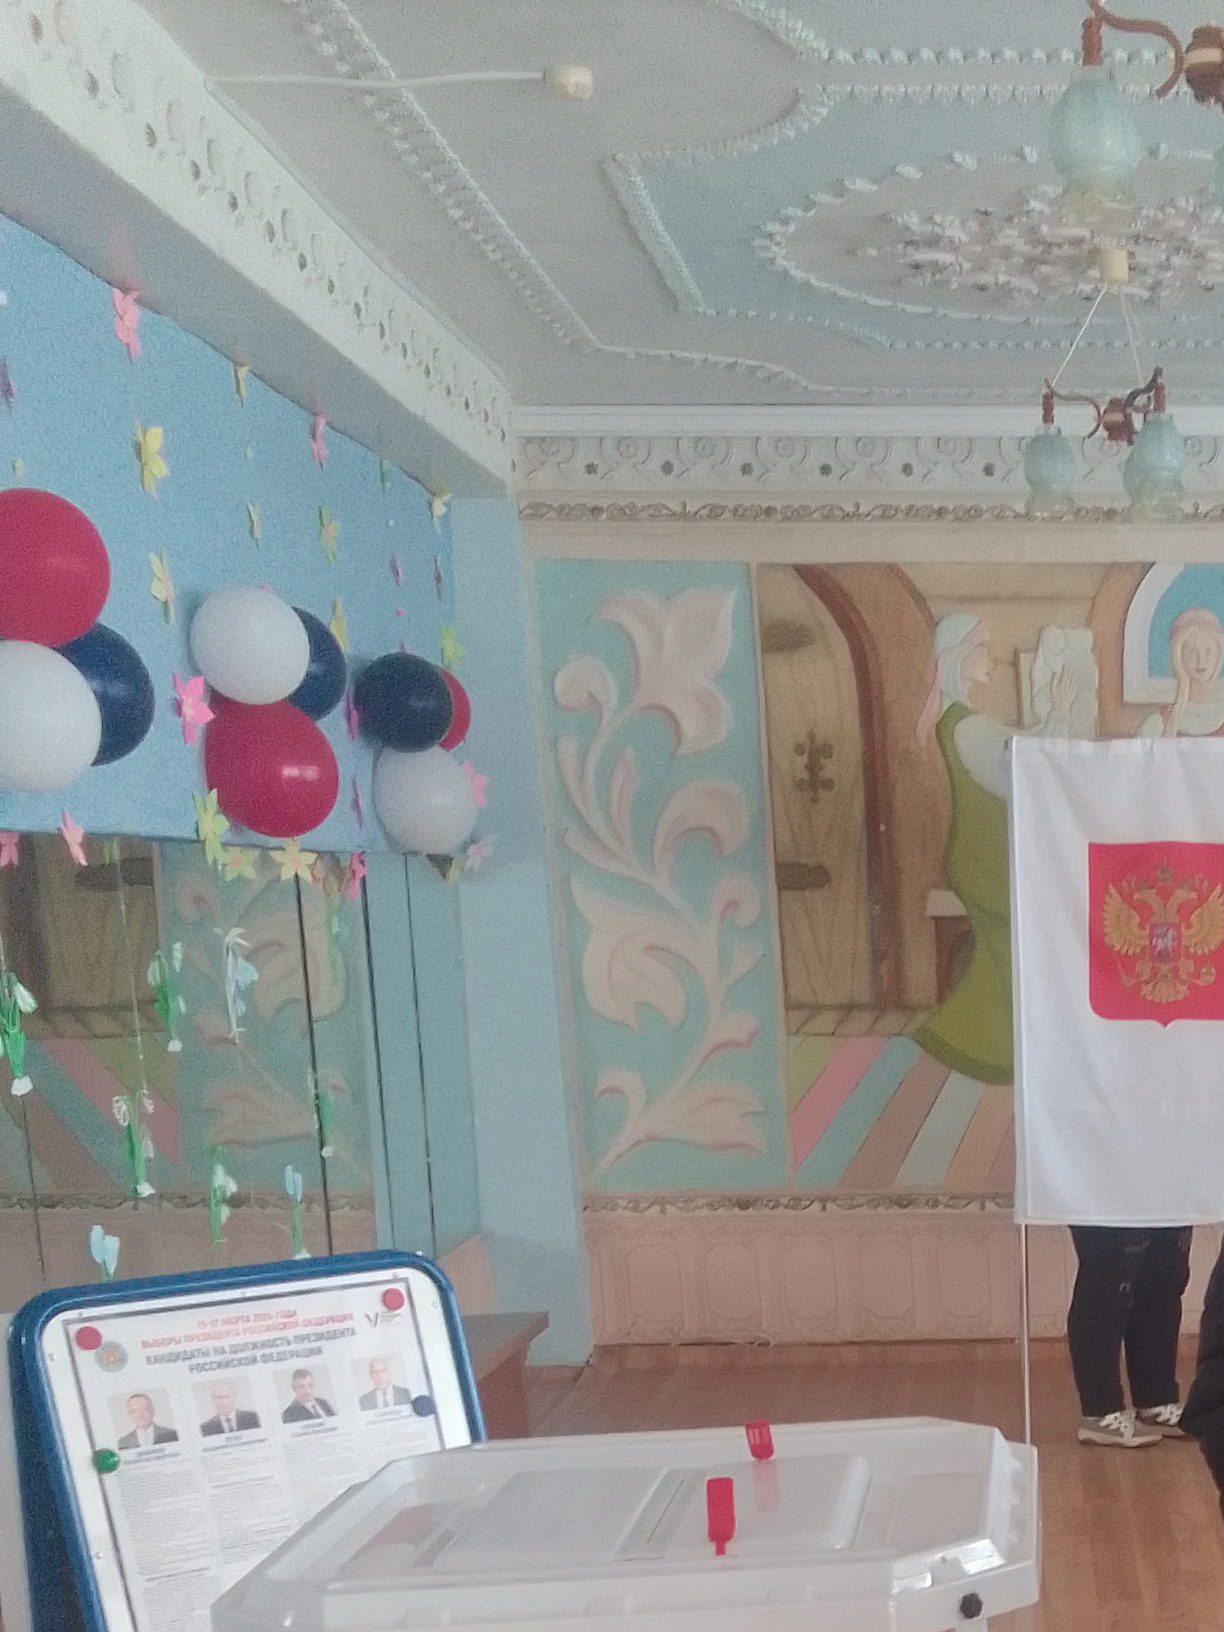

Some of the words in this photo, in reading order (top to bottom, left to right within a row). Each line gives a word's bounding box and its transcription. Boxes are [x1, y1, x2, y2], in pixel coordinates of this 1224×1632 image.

[145, 1347, 211, 1366] КАНДИДАТЫ
[212, 1345, 228, 1357] НА
[228, 1336, 292, 1354] ДОЛЖНОСТЬ
[292, 1327, 357, 1345] ПРЕЗИДЕНТА
[188, 1354, 259, 1374] РОССИЙСКОЙ
[259, 1345, 323, 1364] ФЕДЕРАЦИИ
